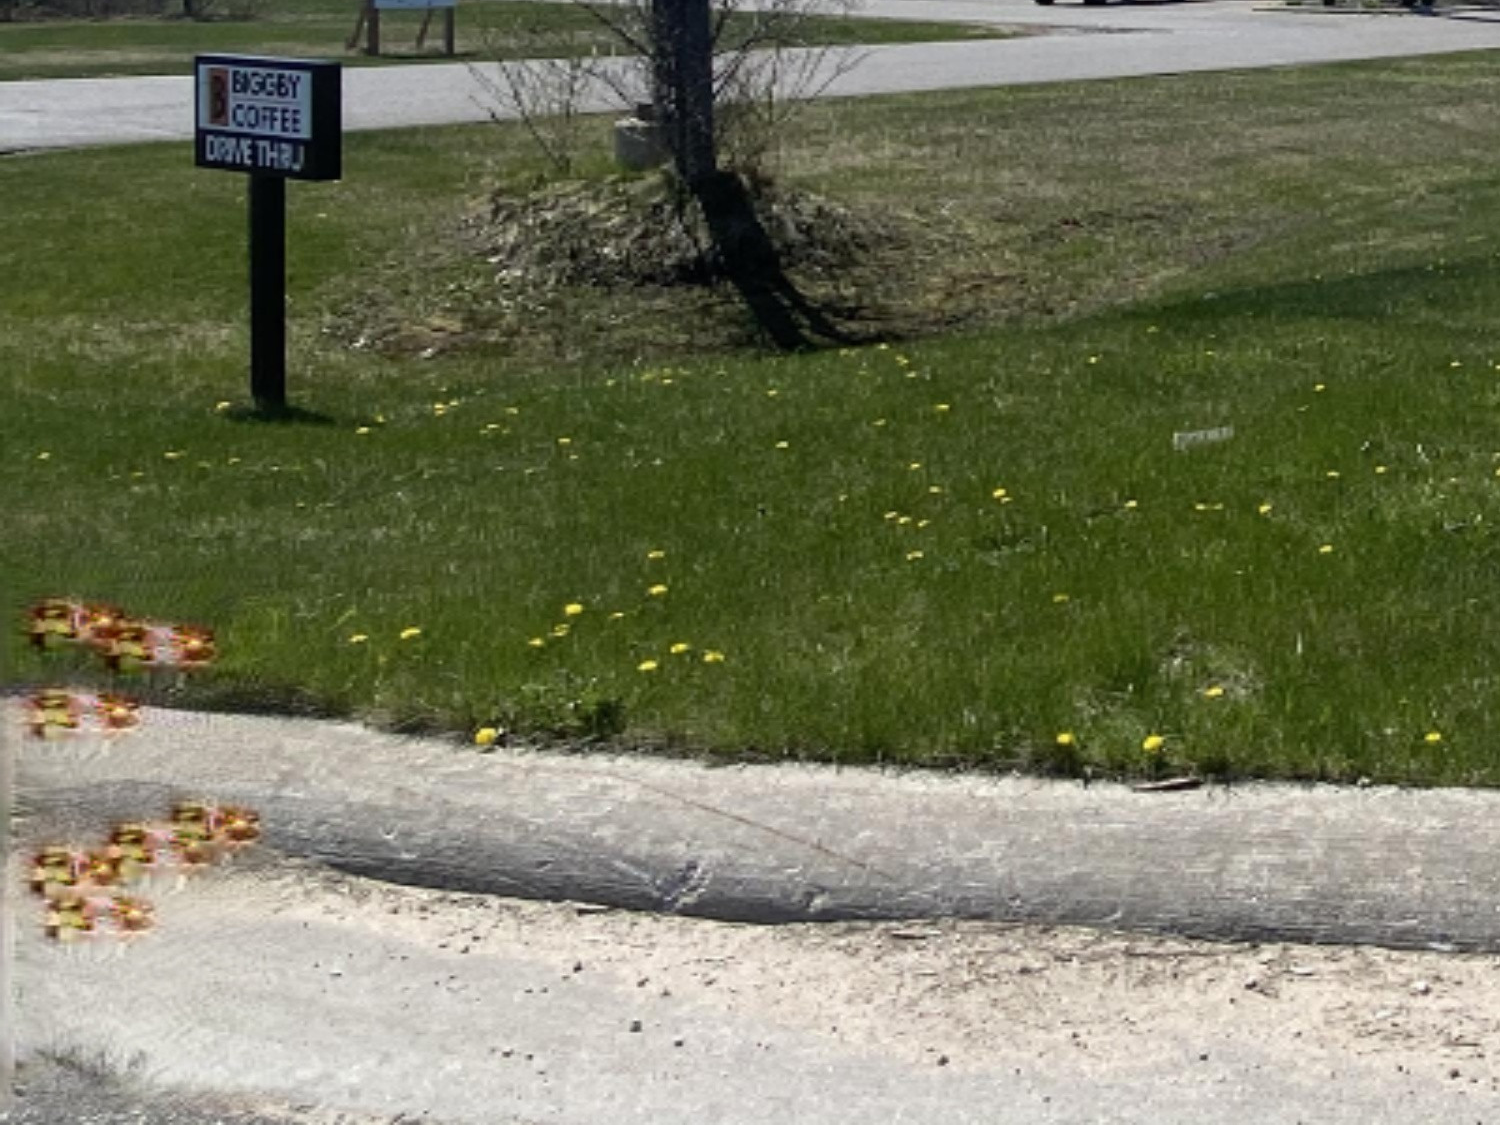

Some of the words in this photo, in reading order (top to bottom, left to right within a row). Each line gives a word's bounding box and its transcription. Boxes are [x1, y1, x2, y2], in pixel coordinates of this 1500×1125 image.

[231, 70, 301, 99] BIGGBY
[231, 104, 301, 133] COFFEE
[205, 134, 252, 165] DRIVE
[254, 139, 305, 172] THRU
